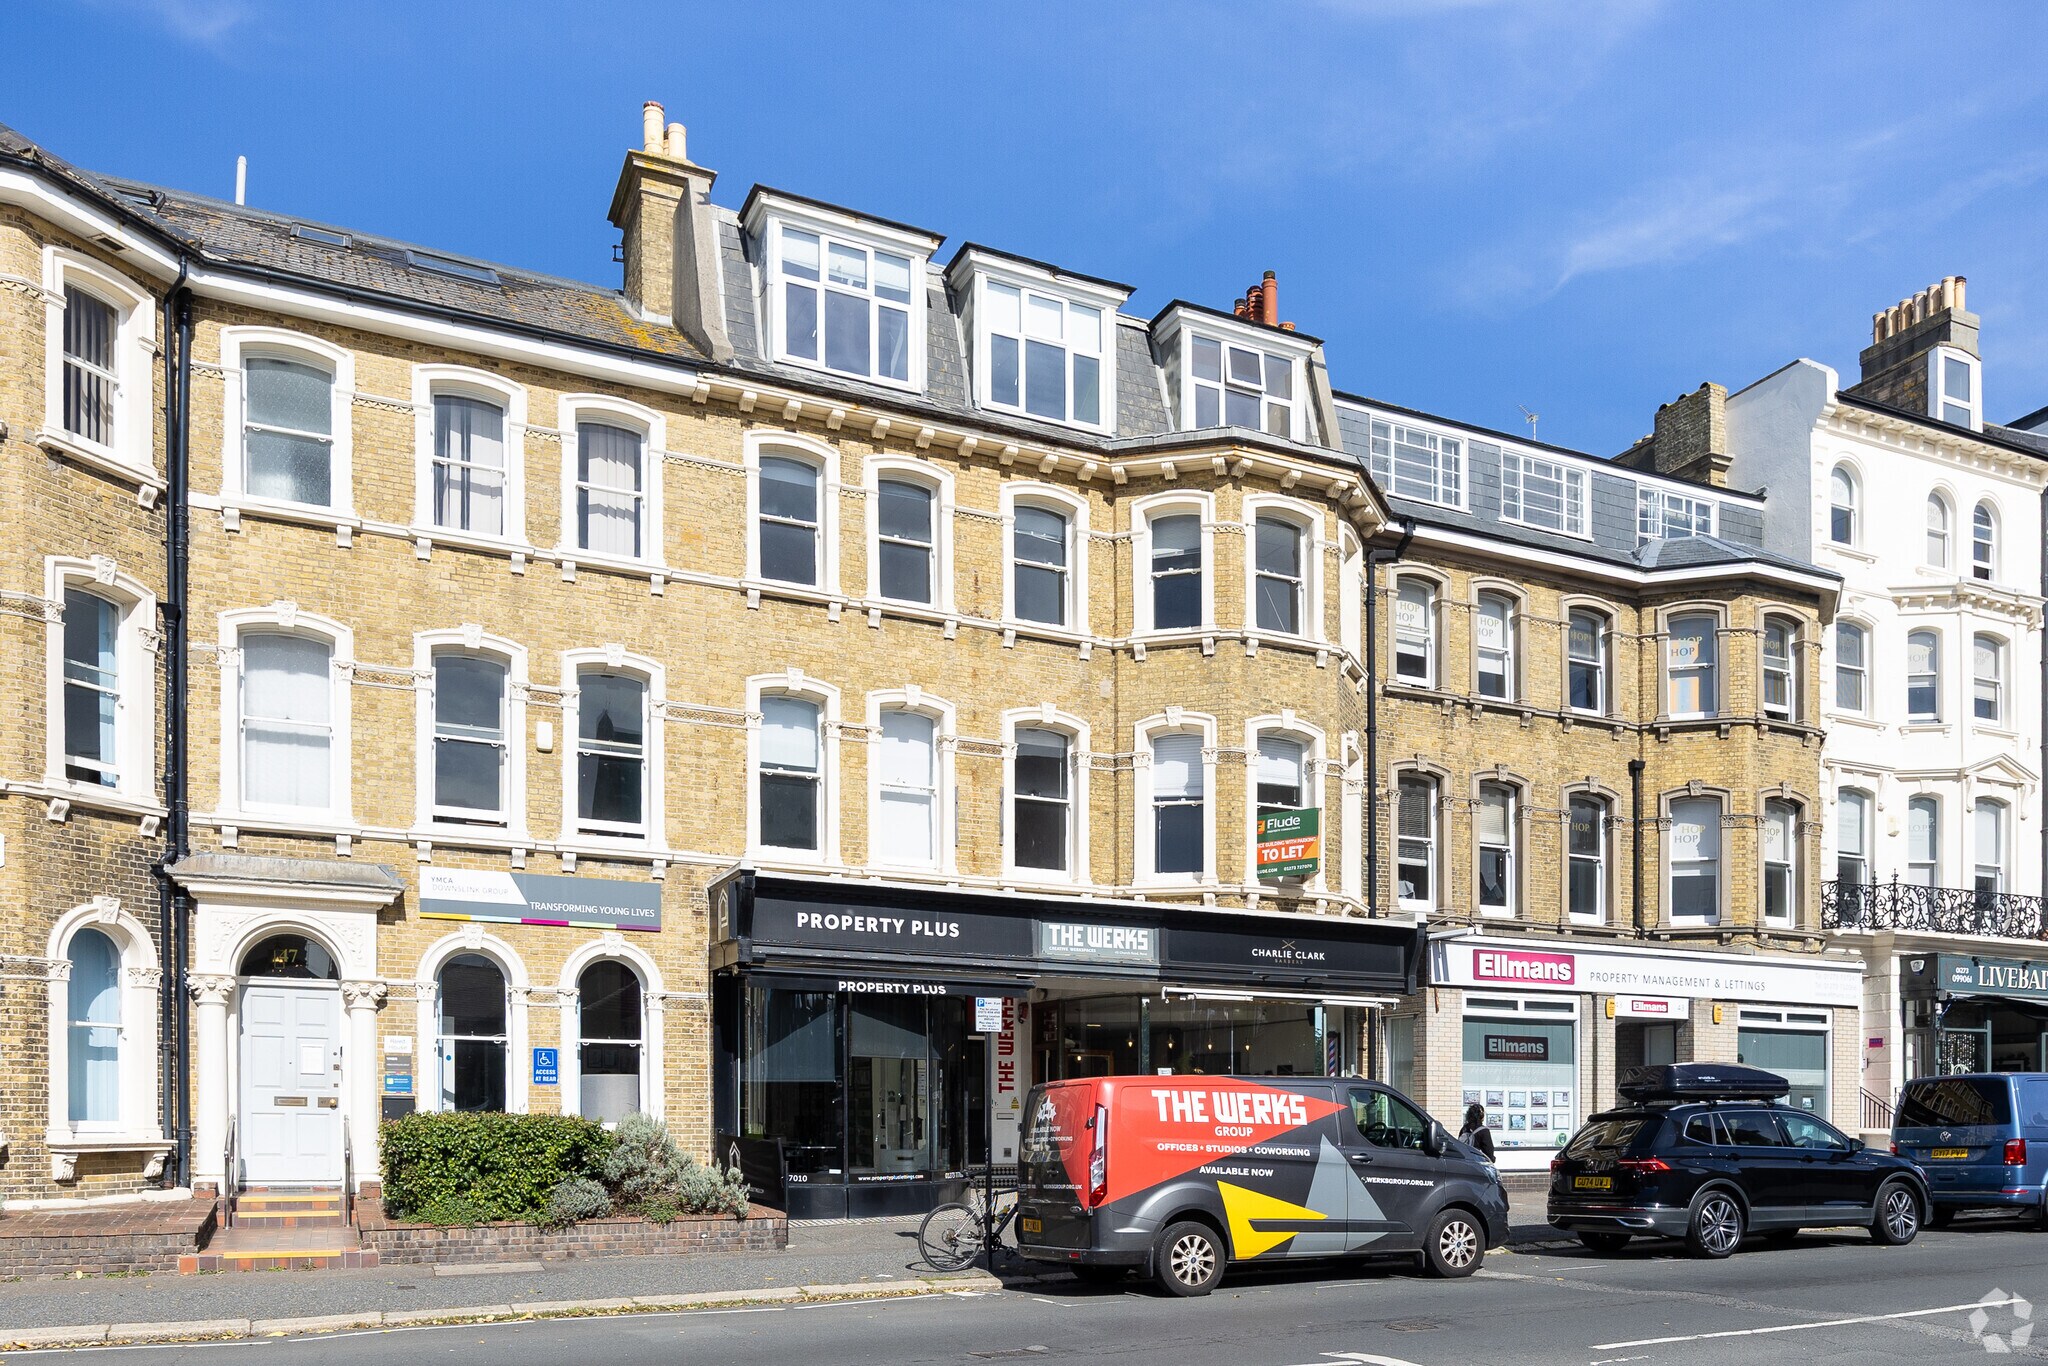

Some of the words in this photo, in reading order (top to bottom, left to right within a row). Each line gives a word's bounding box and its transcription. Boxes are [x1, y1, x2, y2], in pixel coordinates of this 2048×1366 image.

[1400, 602, 1420, 612] HOP
[1480, 618, 1499, 627] HOP
[1671, 647, 1695, 657] HOP
[1267, 816, 1300, 829] Flude
[1572, 822, 1590, 832] HOP
[1682, 825, 1706, 834] HOP
[1764, 827, 1780, 836] HOP
[1674, 834, 1699, 844] HOP
[1763, 836, 1774, 844] OP
[1262, 848, 1279, 861] TO
[1281, 845, 1304, 859] LET
[431, 876, 453, 884] YMCA
[482, 887, 509, 895] GROUP
[530, 901, 598, 914] TRANSFORMING
[598, 905, 630, 916] YOUNG
[631, 907, 655, 918] LIVES
[797, 912, 905, 934] PROPERTY
[911, 920, 960, 938] PLUS
[1048, 924, 1084, 947] THE
[1087, 926, 1148, 950] WERKS
[1251, 948, 1292, 959] CHARLIE
[1295, 951, 1325, 961] CLARK
[1479, 953, 1572, 981] Ellmans
[1589, 971, 1639, 984] PROPERTY
[1643, 974, 1711, 988] MANAGEMENT
[1714, 979, 1721, 988] &
[1725, 979, 1766, 991] LETTINGS
[1952, 973, 1973, 984] 099061
[1978, 965, 2048, 990] LIVEBAI
[838, 981, 909, 994] PROPERTY
[913, 984, 947, 995] PLUS
[1633, 1002, 1667, 1012] Ellmans
[1488, 1038, 1544, 1054] Ellmans
[998, 1060, 1014, 1093] THE
[1151, 1089, 1209, 1123] THE
[1211, 1091, 1308, 1126] WERKS
[1215, 1126, 1253, 1137] GROUP
[1157, 1142, 1199, 1152] OFFICES
[1205, 1144, 1247, 1154] STUDIOS
[1254, 1146, 1310, 1157] COWORKING
[1199, 1166, 1250, 1176] AVAILABLE
[1251, 1168, 1274, 1177] NOW
[788, 1174, 808, 1183] 7010
